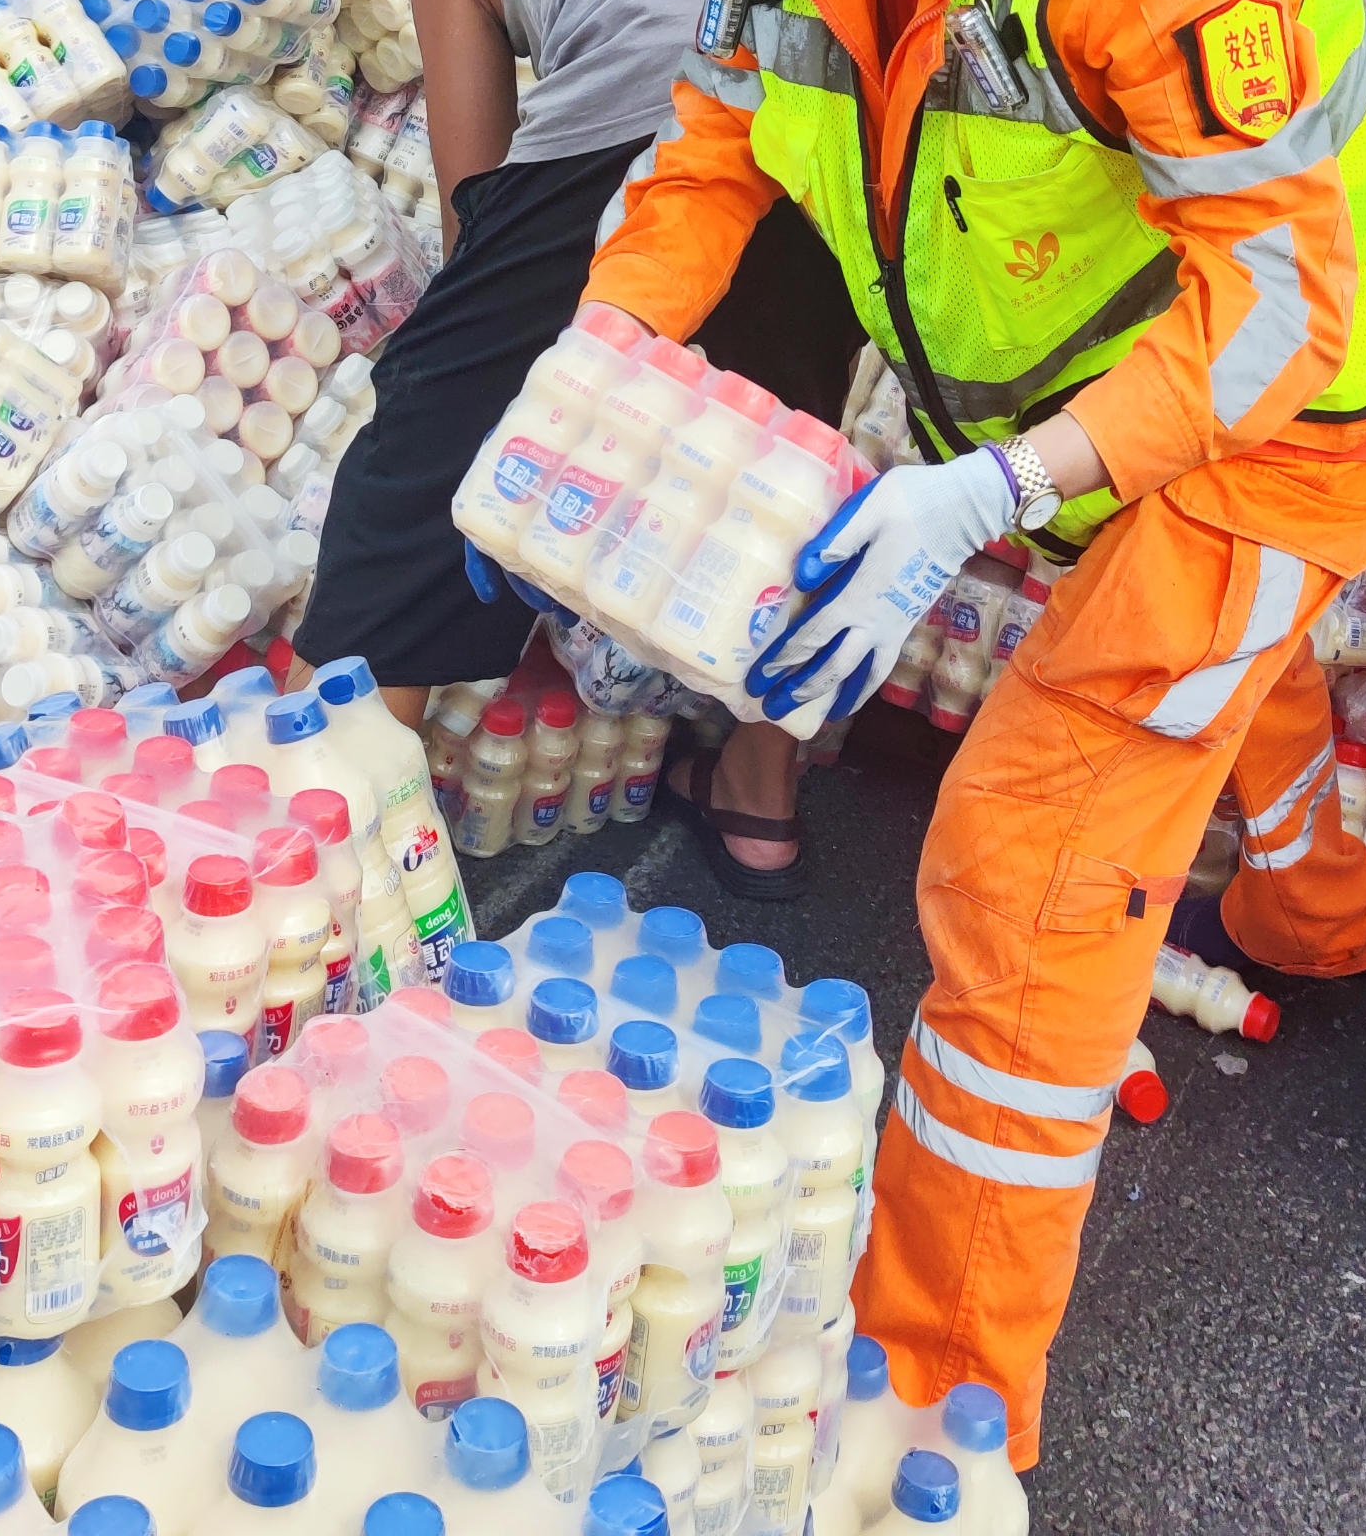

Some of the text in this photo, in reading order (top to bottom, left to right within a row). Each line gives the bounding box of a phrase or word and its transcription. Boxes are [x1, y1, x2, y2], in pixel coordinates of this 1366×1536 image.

[1224, 21, 1276, 74] 安全员
[7, 211, 43, 230] 胃动力
[59, 210, 84, 228] 胃动力
[500, 455, 544, 492] 胃动力
[577, 472, 602, 495] dong
[552, 485, 597, 523] 胃动力
[425, 908, 453, 932] dong
[421, 925, 468, 969] 胃动力
[127, 1095, 187, 1117] 初元益生食品
[25, 1124, 85, 1150] 常喝肠美丽
[151, 1184, 182, 1204] dong
